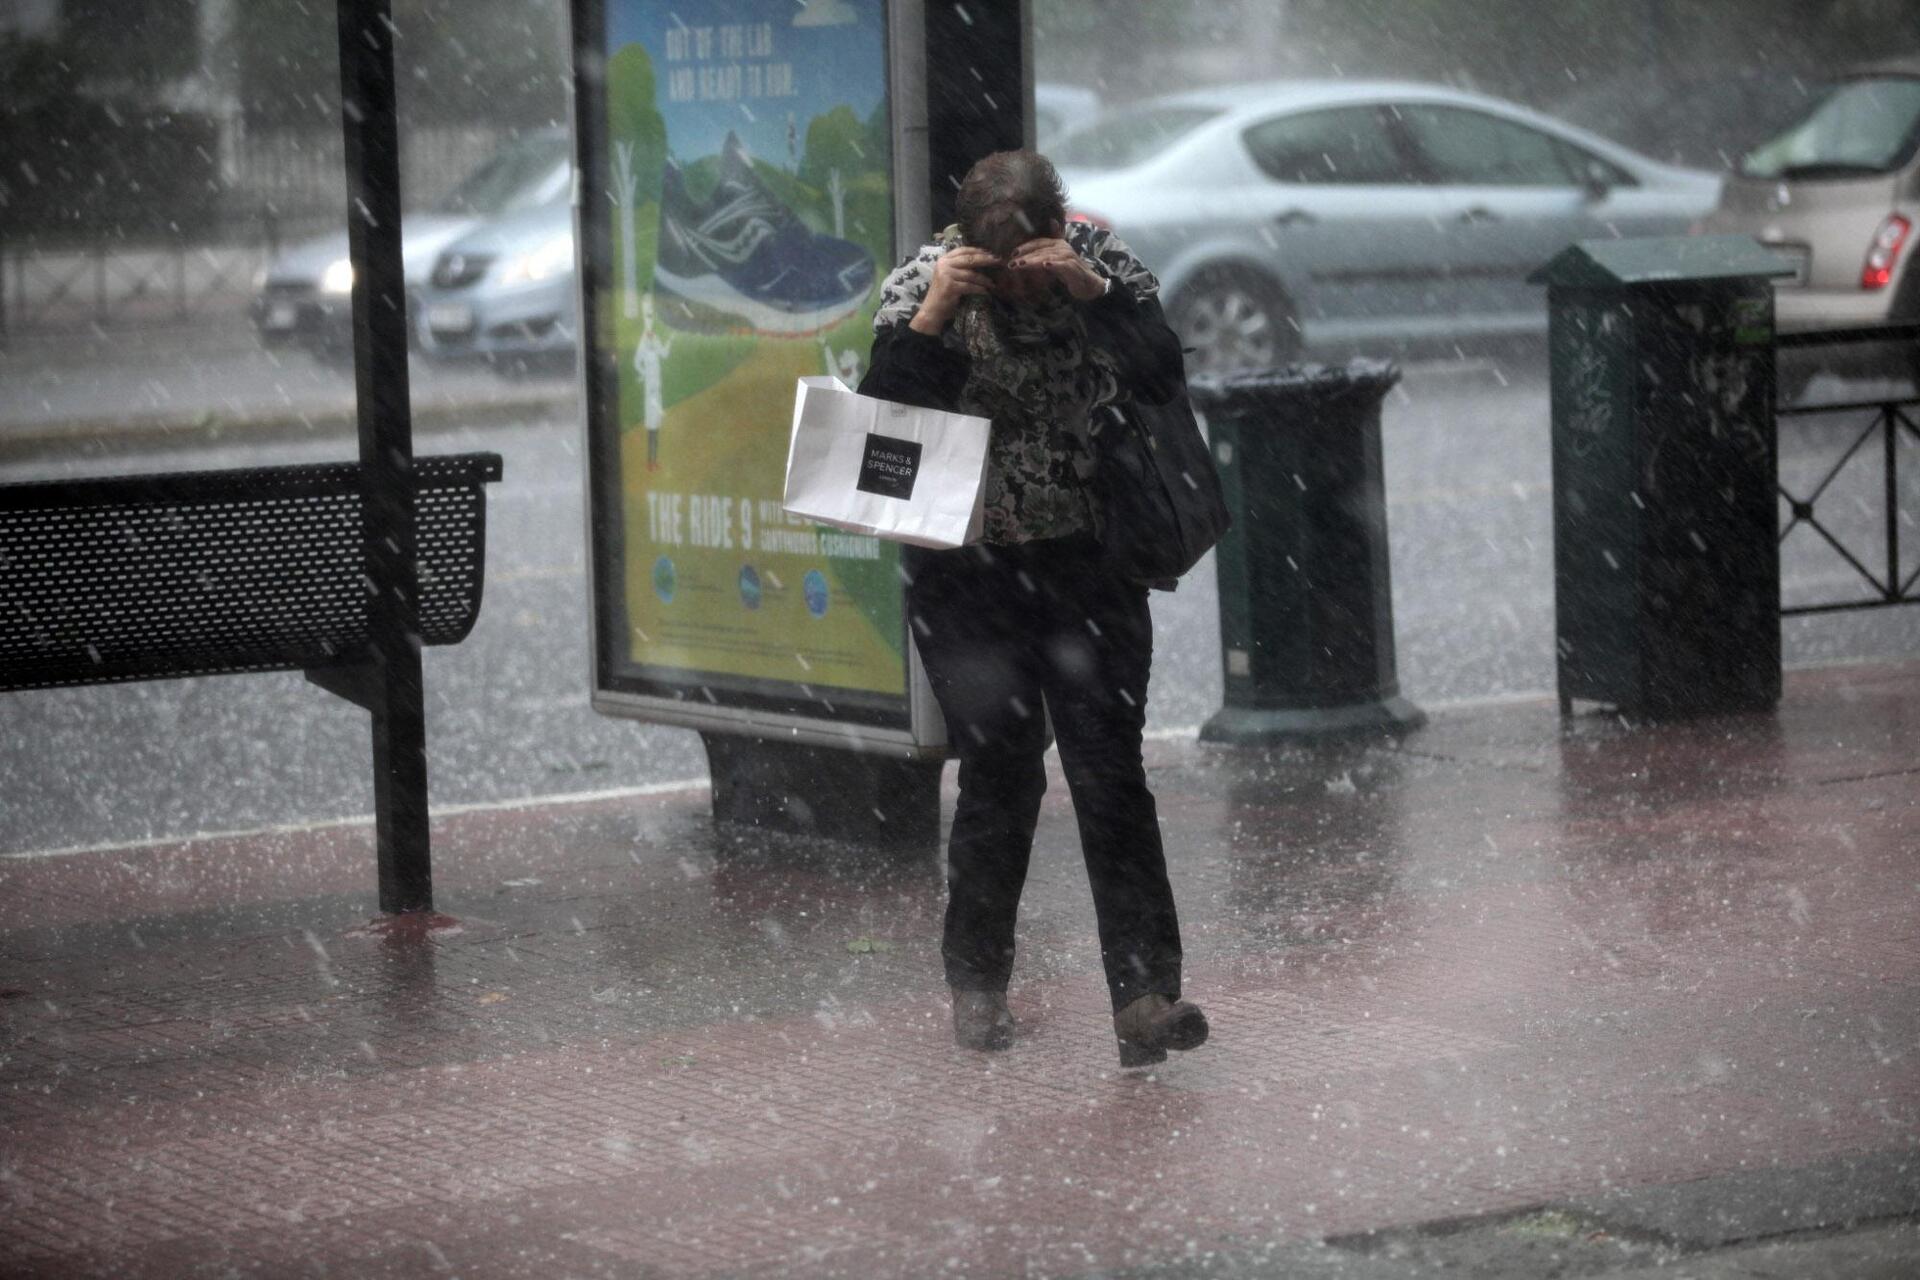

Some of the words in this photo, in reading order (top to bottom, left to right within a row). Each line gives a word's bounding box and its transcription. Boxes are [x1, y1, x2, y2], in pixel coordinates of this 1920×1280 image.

[871, 449, 904, 464] MARKS
[905, 456, 912, 465] &
[867, 460, 912, 477] SPENCER
[647, 491, 682, 545] THE
[690, 495, 732, 549] RIDE
[740, 497, 752, 550] 9
